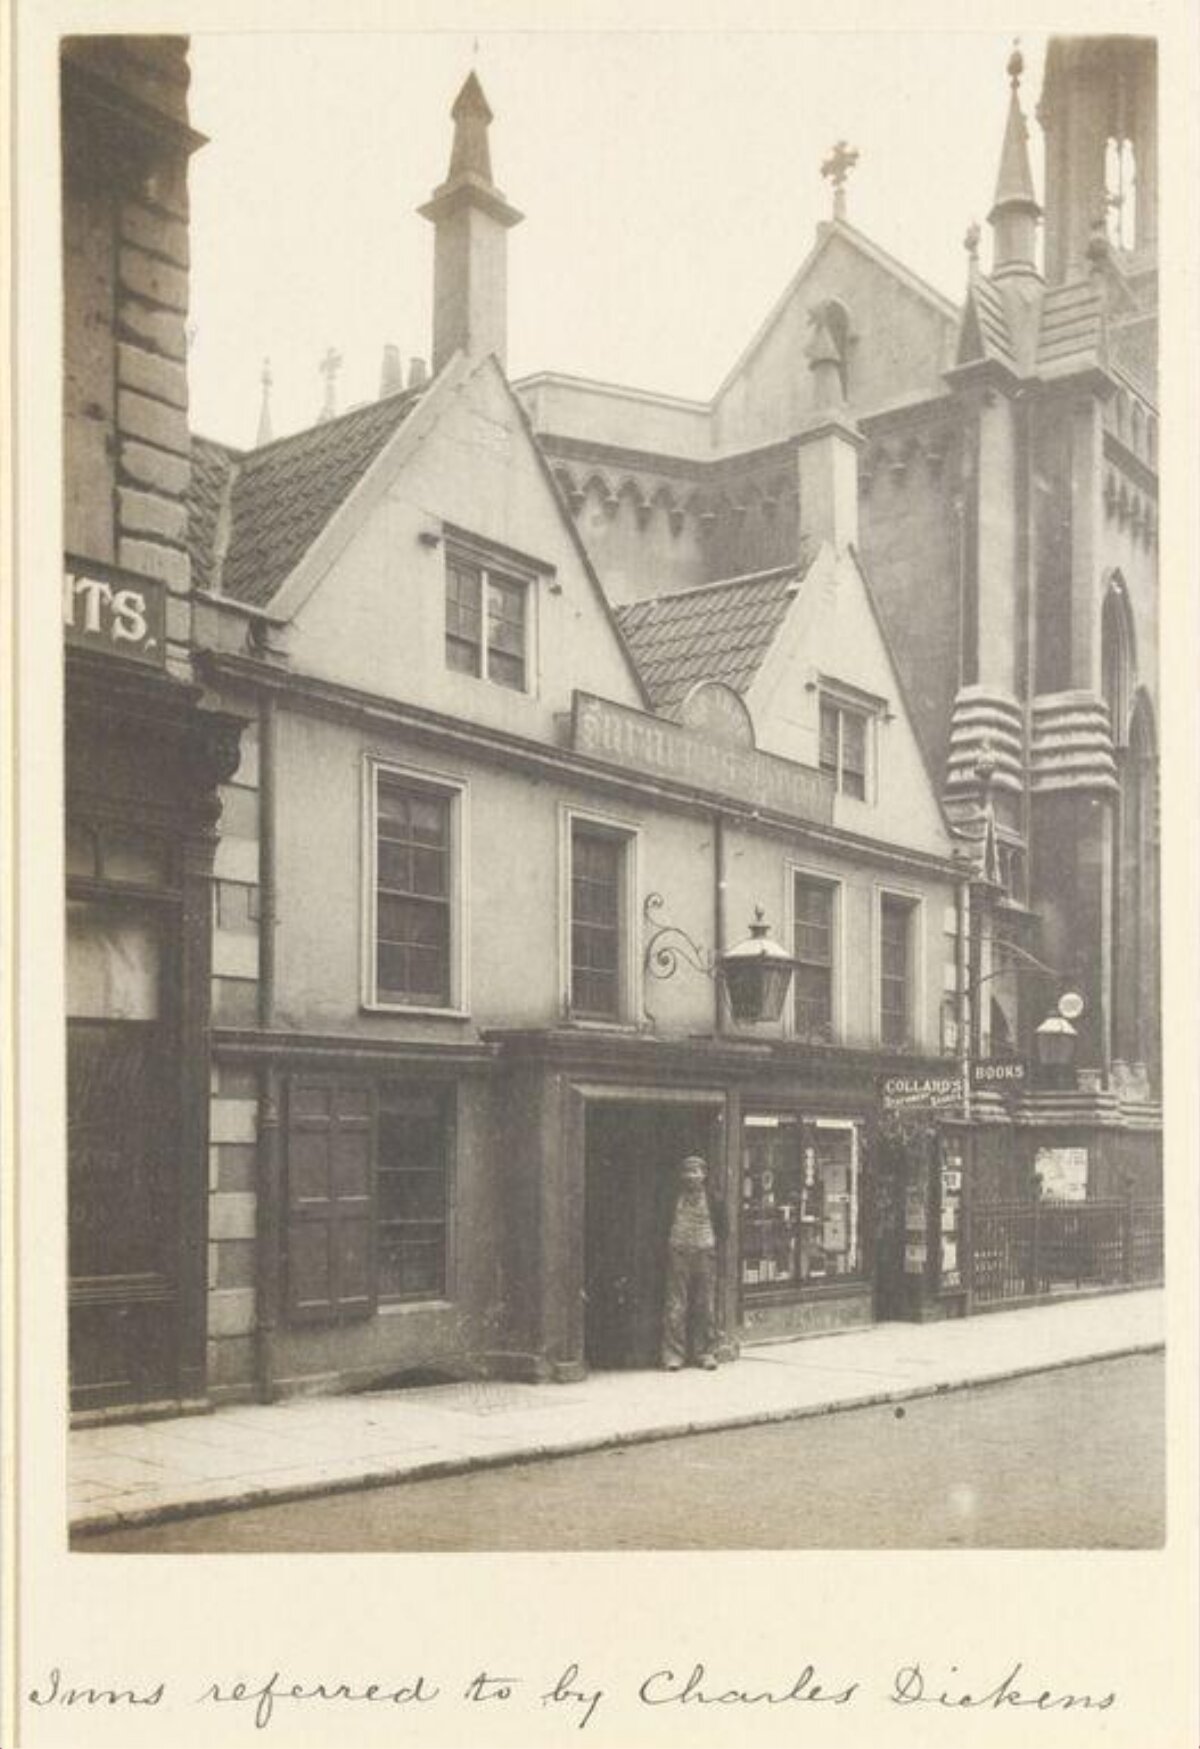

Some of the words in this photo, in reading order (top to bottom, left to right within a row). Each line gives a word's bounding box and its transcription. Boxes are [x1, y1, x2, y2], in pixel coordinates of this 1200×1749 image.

[976, 1064, 1024, 1080] BOOKS
[28, 1667, 165, 1706] Inns
[199, 1671, 440, 1729] referred
[464, 1672, 524, 1702] to
[541, 1664, 606, 1729] by
[638, 1663, 860, 1705] Charles
[890, 1662, 1118, 1710] Dickens
